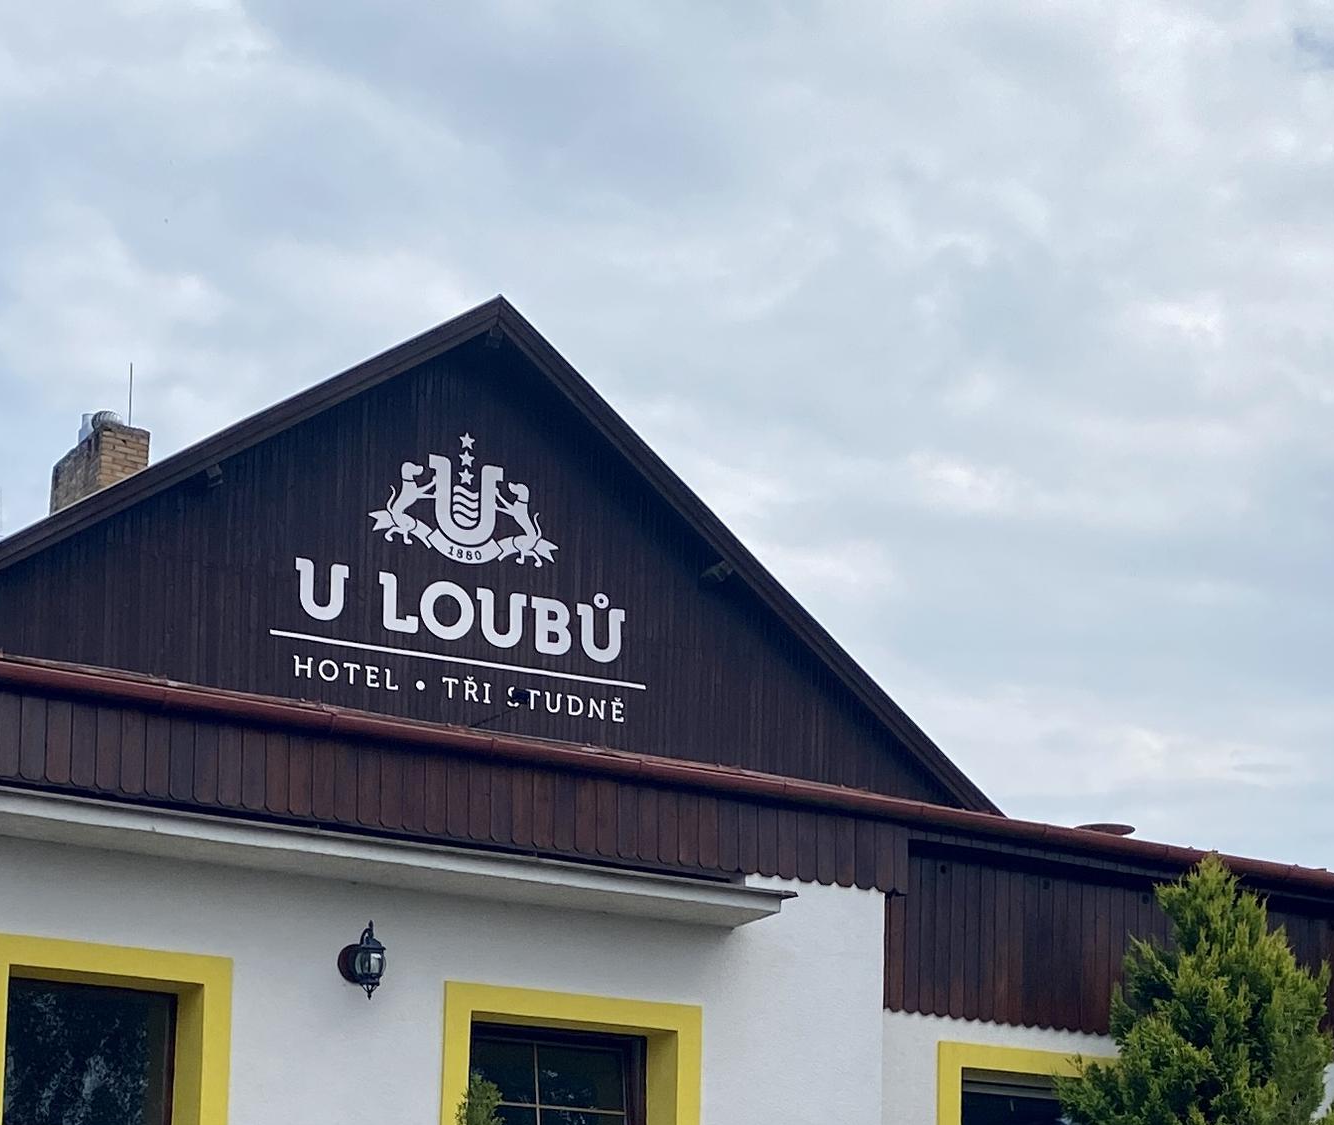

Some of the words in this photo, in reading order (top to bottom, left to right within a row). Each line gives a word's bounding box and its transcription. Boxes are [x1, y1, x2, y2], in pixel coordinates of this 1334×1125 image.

[447, 545, 482, 561] 1880
[295, 557, 350, 621] U
[378, 571, 626, 663] LOUBŮ
[293, 654, 399, 691] HOTEL
[441, 675, 492, 704] TŘI
